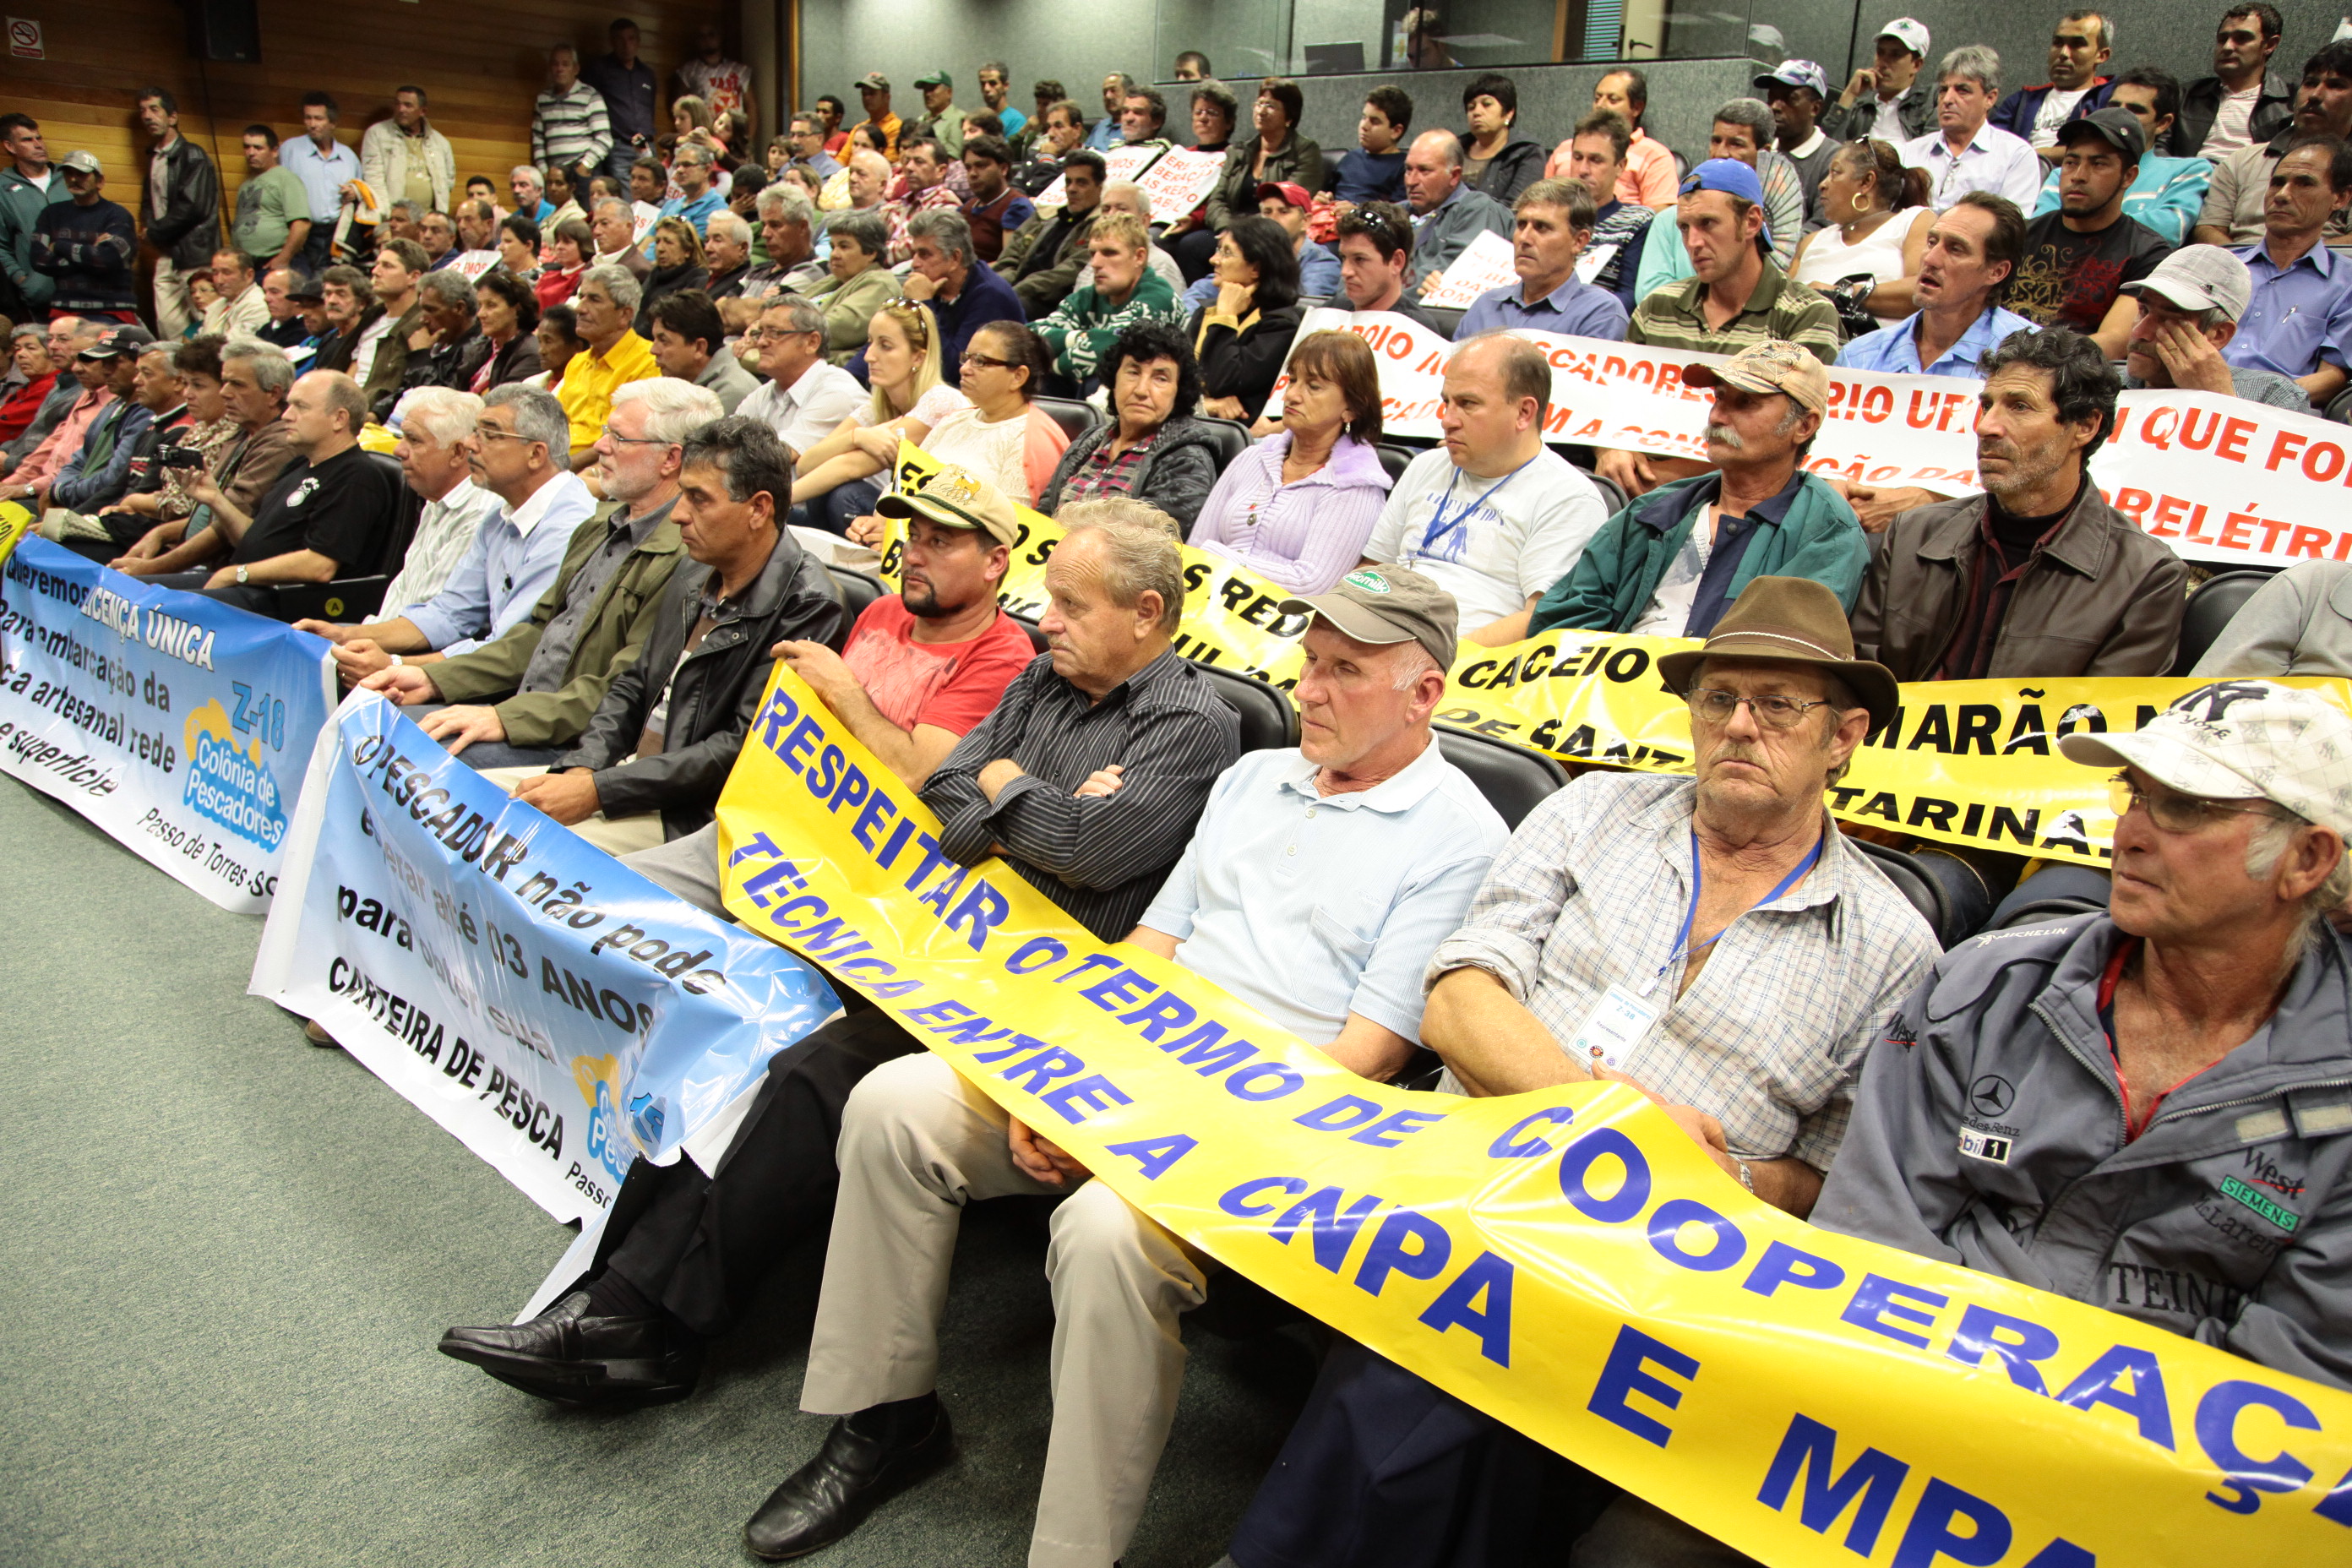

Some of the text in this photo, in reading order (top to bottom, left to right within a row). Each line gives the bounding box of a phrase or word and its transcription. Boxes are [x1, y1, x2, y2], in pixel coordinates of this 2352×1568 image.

[1827, 382, 1894, 423] RIO
[2140, 406, 2258, 464] QUE
[2264, 429, 2352, 488] FO
[6, 551, 217, 672] Queremos LICENÇA ÚNICA
[37, 624, 137, 699] embarcação
[143, 670, 172, 714] da
[1457, 644, 1650, 691] CACEIO
[30, 680, 125, 748] artesanal
[128, 725, 177, 774] rede
[231, 680, 286, 753] Z-18
[1527, 718, 1687, 769] SANT
[187, 767, 286, 846] Pescadores
[198, 738, 275, 808] Colônia de
[136, 807, 185, 847] Passo
[182, 833, 205, 860] de
[367, 743, 529, 884] PESCADOR
[514, 870, 607, 930] não
[591, 923, 727, 995] pode
[433, 888, 479, 946] até
[485, 919, 529, 979] 03
[1992, 927, 2068, 939] MICHELIN
[336, 884, 414, 953] para
[487, 1004, 559, 1067] sua
[329, 956, 565, 1162] CARTEIRA DE PESCA
[1596, 1020, 1627, 1043] Representante
[752, 686, 2352, 1516] RESPEITAR O TERMO DE COOPERAÇ
[1963, 1114, 2021, 1137] edes-Benz
[2224, 1179, 2294, 1228] SIEMENS
[2243, 1146, 2306, 1200] West
[897, 999, 1135, 1125] ENTRE
[1104, 1133, 1200, 1179] A
[1217, 1176, 1516, 1370] CNPA
[1586, 1322, 1701, 1450] E
[1756, 1412, 2099, 1568] MP
